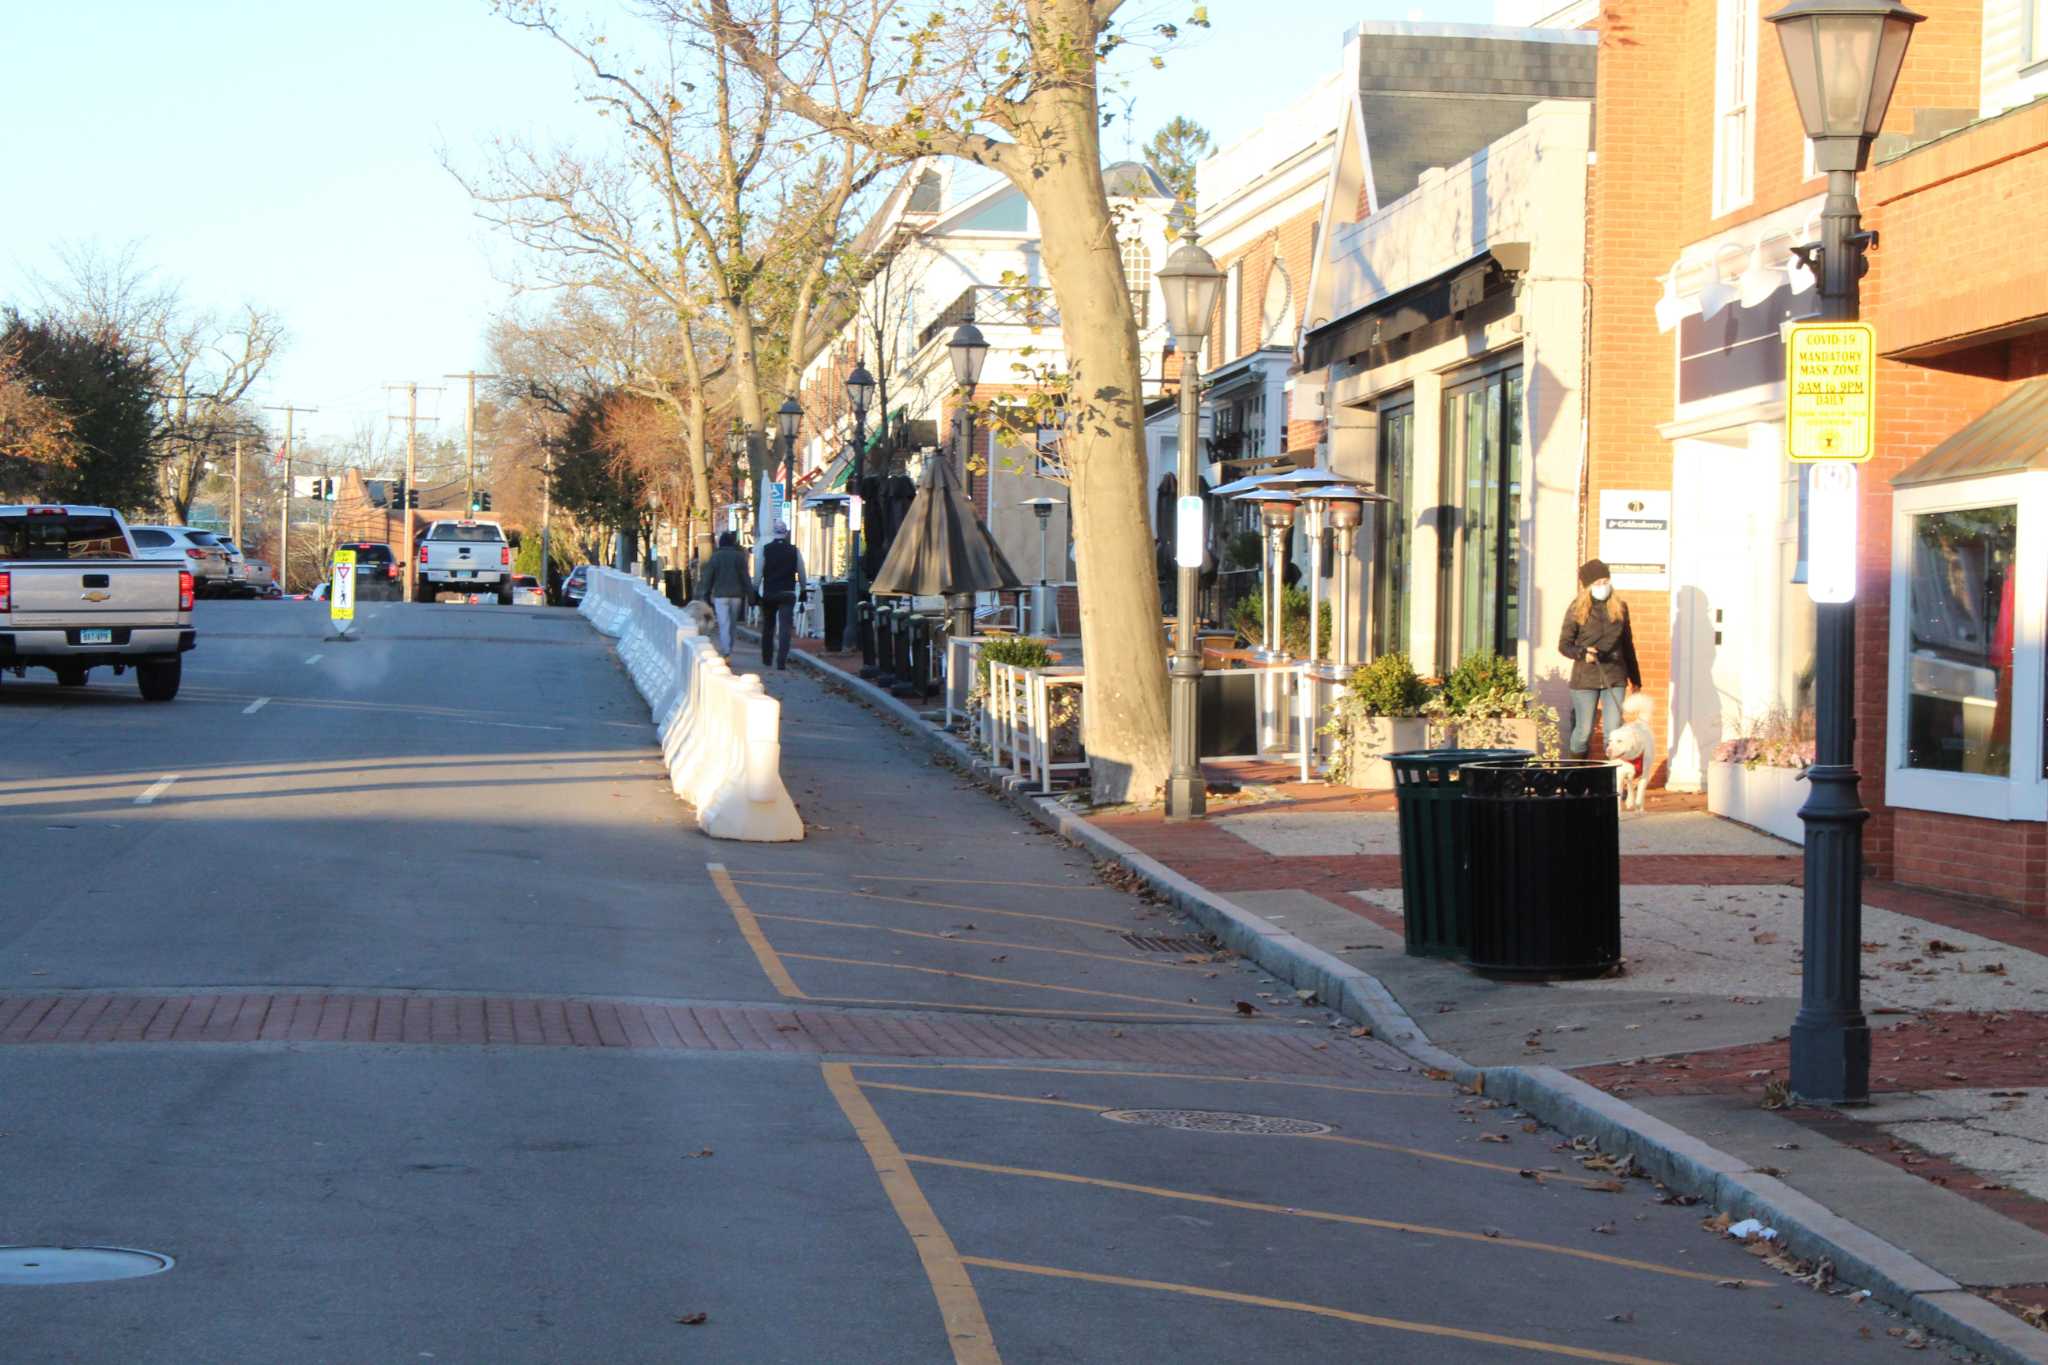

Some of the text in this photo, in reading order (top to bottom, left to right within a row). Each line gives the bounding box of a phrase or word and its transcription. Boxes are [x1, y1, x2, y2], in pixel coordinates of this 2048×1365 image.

[1806, 334, 1856, 345] COVID-19
[1799, 351, 1862, 362] MANDATORY
[1800, 364, 1861, 376] MASK ZONE
[1798, 381, 1863, 393] 9AM to 9PM
[1816, 395, 1845, 406] DAILY
